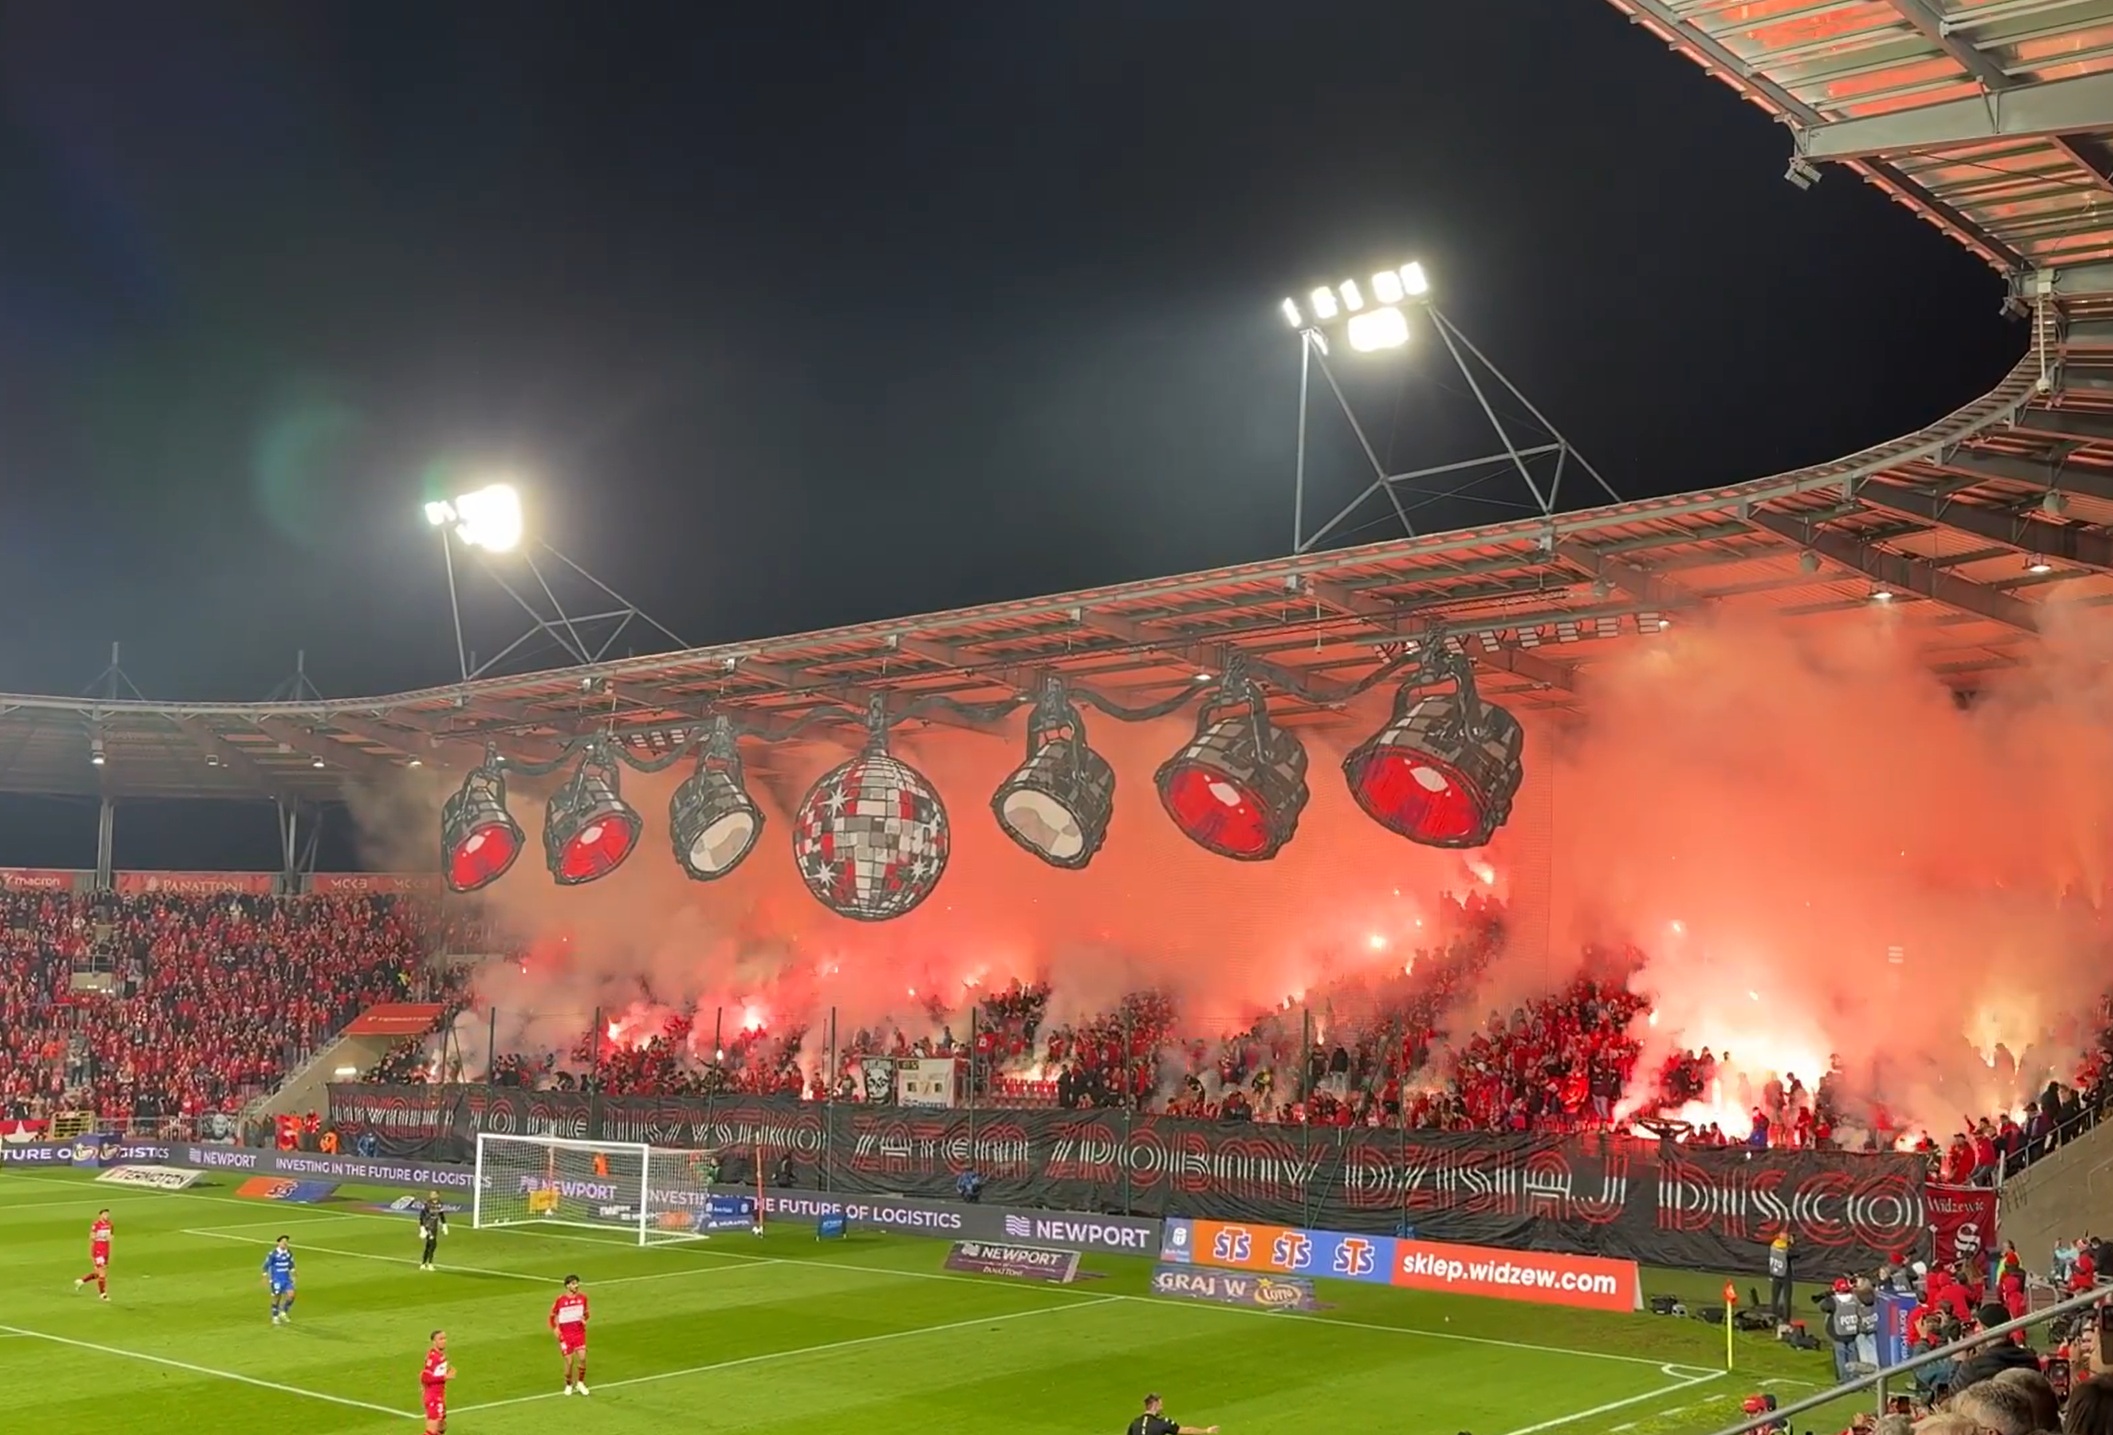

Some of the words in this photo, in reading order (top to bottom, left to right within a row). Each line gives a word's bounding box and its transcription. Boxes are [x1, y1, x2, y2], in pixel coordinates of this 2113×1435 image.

[14, 877, 61, 887] macron
[163, 879, 243, 892] PANATTONI
[203, 1152, 257, 1168] NEWPORT
[276, 1158, 330, 1174] INVESTING
[332, 1163, 343, 1175] IN
[345, 1164, 366, 1178] THE
[369, 1166, 412, 1181] FUTURE
[413, 1169, 430, 1183] OF
[540, 1179, 617, 1200] NEWPORT
[852, 1115, 1030, 1178] ZATEM
[1044, 1115, 1330, 1200] ZRÓBMY
[1345, 1145, 1630, 1223] DZISIAJ
[1656, 1160, 1924, 1250] DISCO
[846, 1204, 868, 1220] OF
[873, 1206, 961, 1229] LOGISTICS
[1037, 1219, 1150, 1248] NEWPORT
[1213, 1226, 1252, 1262] STS
[982, 1246, 1061, 1265] NEWPORT
[1271, 1231, 1312, 1269] STS
[1333, 1237, 1375, 1276] STS
[1159, 1272, 1216, 1296] GRAJ
[1224, 1279, 1247, 1297] W
[1403, 1252, 1617, 1294] sklep.widzew.com
